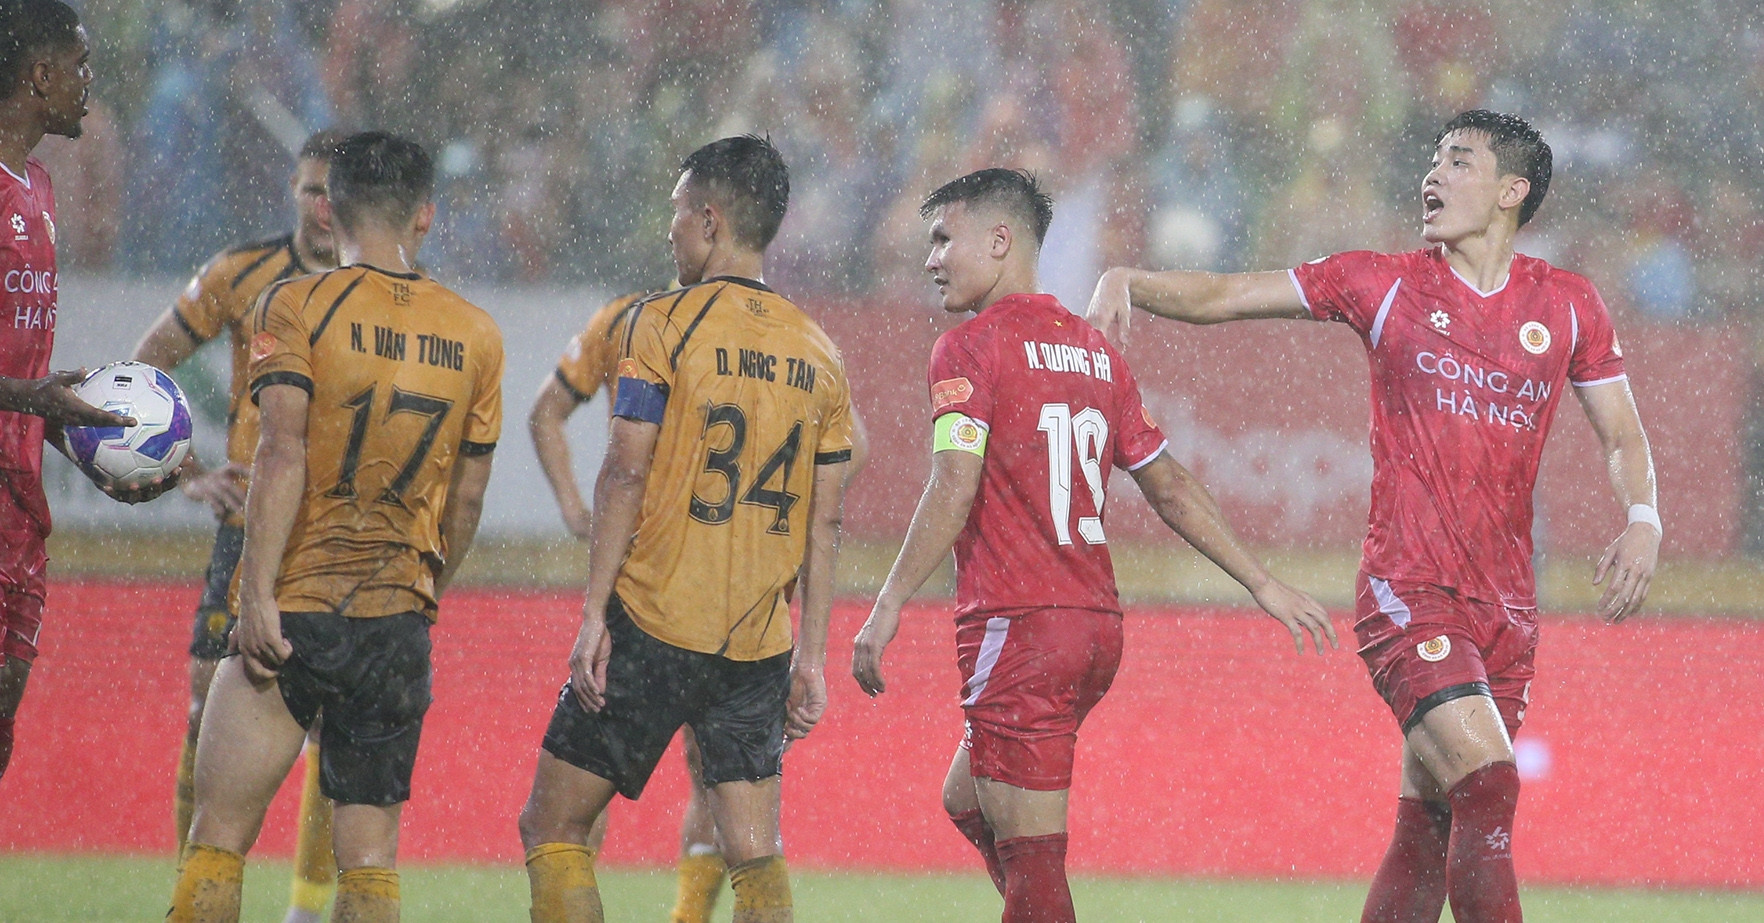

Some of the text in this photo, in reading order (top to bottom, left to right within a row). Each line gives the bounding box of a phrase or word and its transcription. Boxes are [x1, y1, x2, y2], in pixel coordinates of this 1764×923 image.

[14, 300, 41, 329] HÀ
[351, 322, 366, 354] N.
[417, 332, 464, 372] TÙNG
[716, 347, 733, 376] D.
[1416, 350, 1551, 402] CÔNG AN
[1436, 387, 1479, 421] HÀ
[323, 381, 455, 509] 17
[688, 399, 804, 536] 34
[1037, 403, 1109, 545] 19
